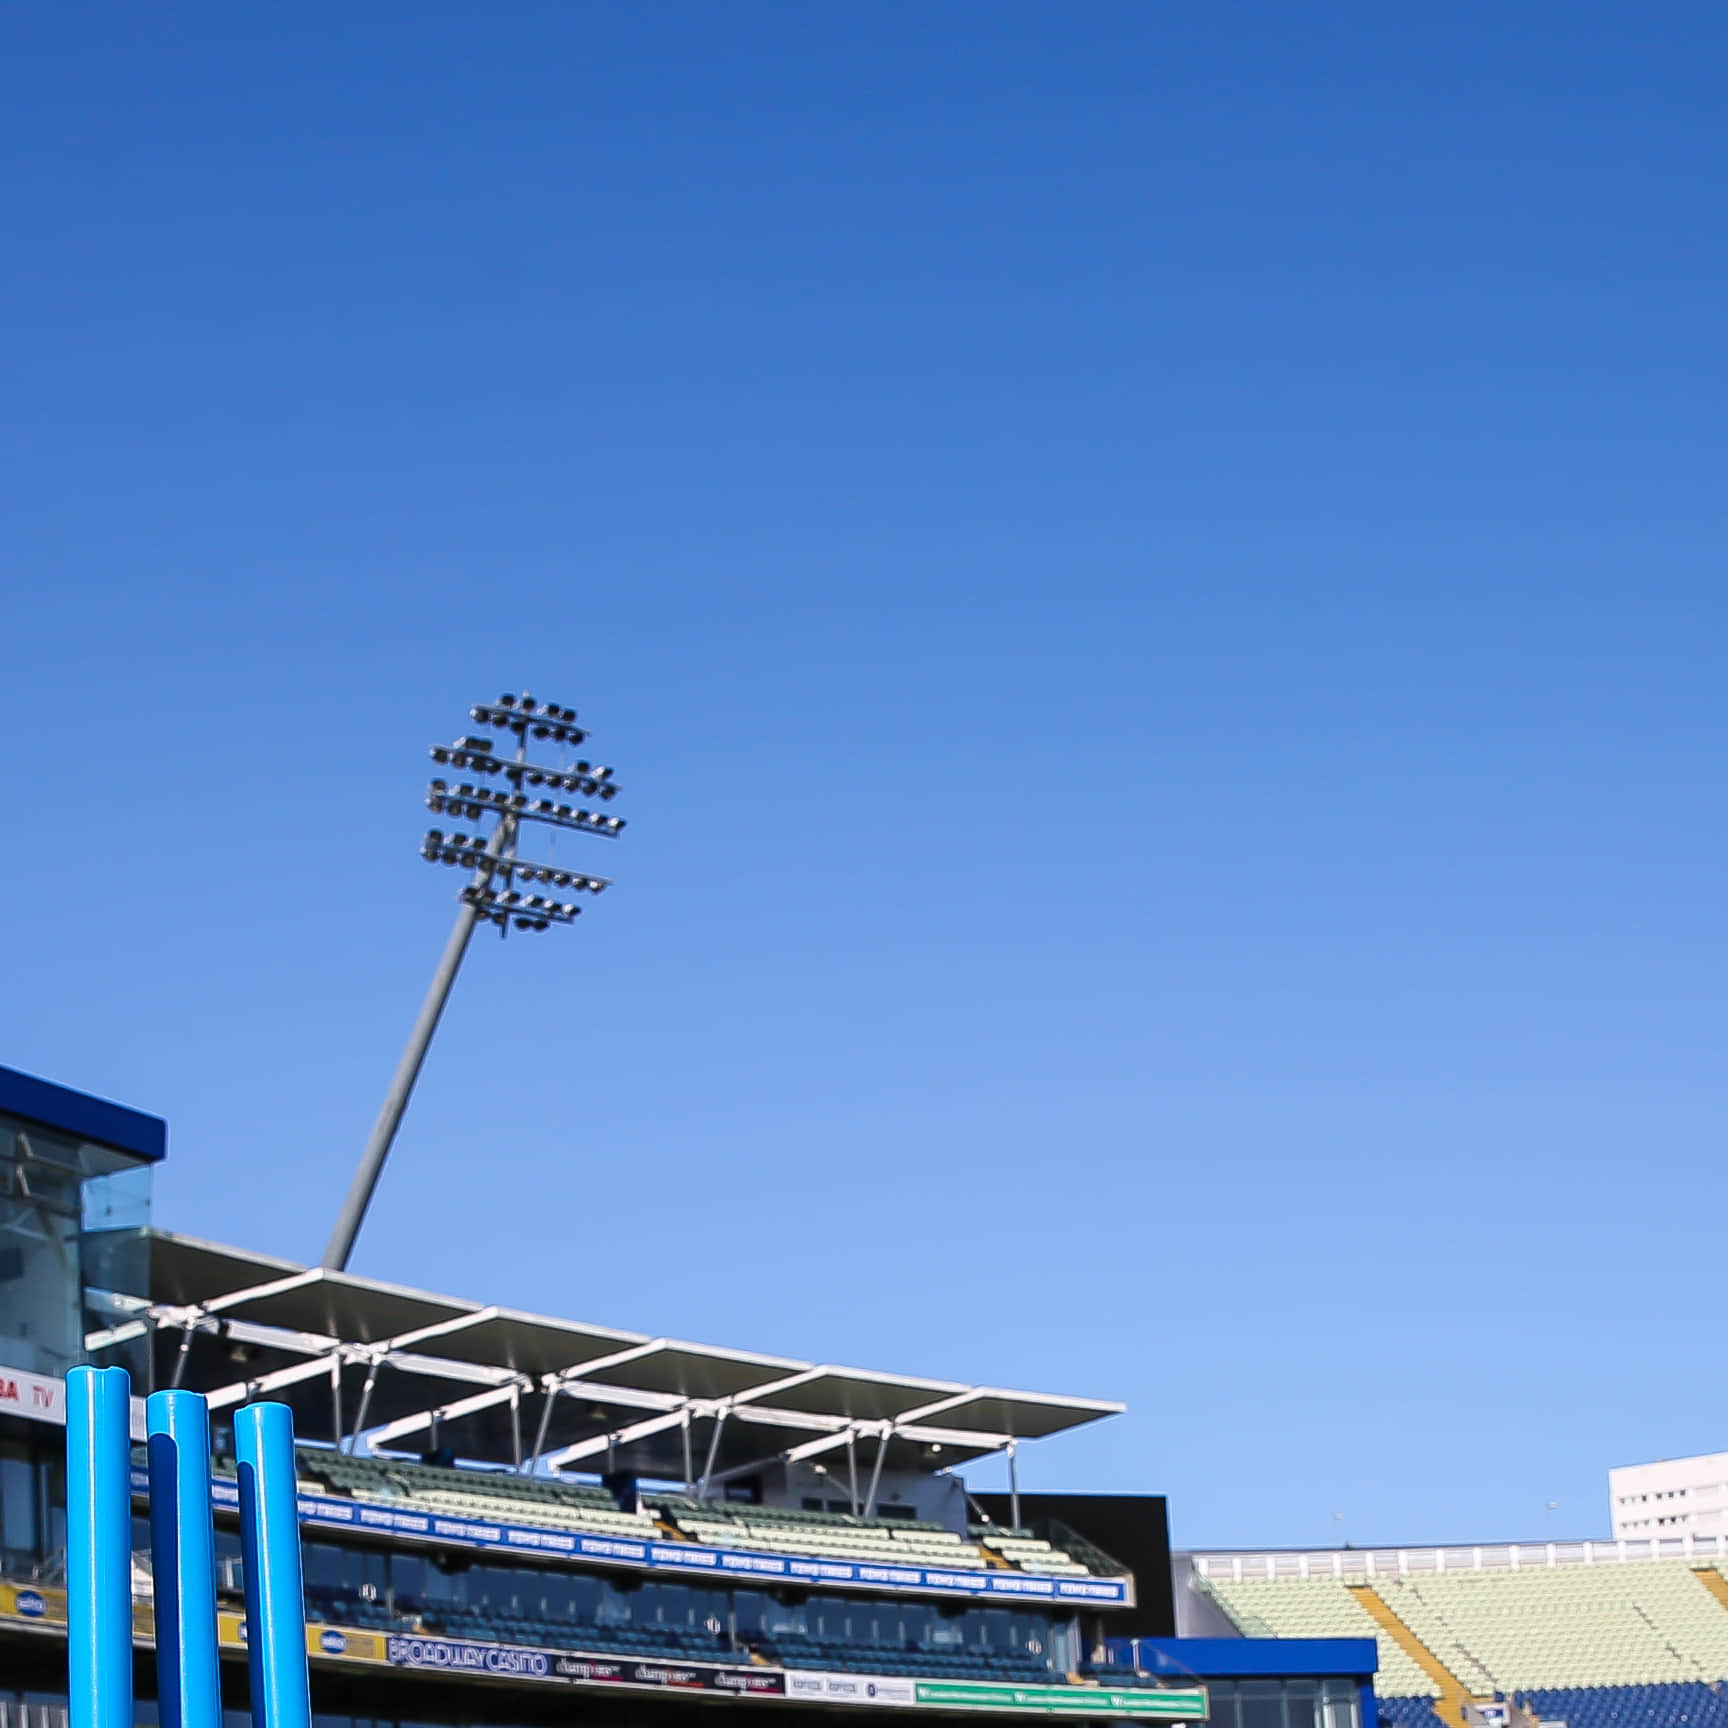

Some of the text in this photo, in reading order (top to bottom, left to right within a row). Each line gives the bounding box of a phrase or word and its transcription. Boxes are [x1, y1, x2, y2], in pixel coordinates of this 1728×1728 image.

[32, 1385, 54, 1408] TV
[389, 1638, 549, 1677] BROADWAY CASINO
